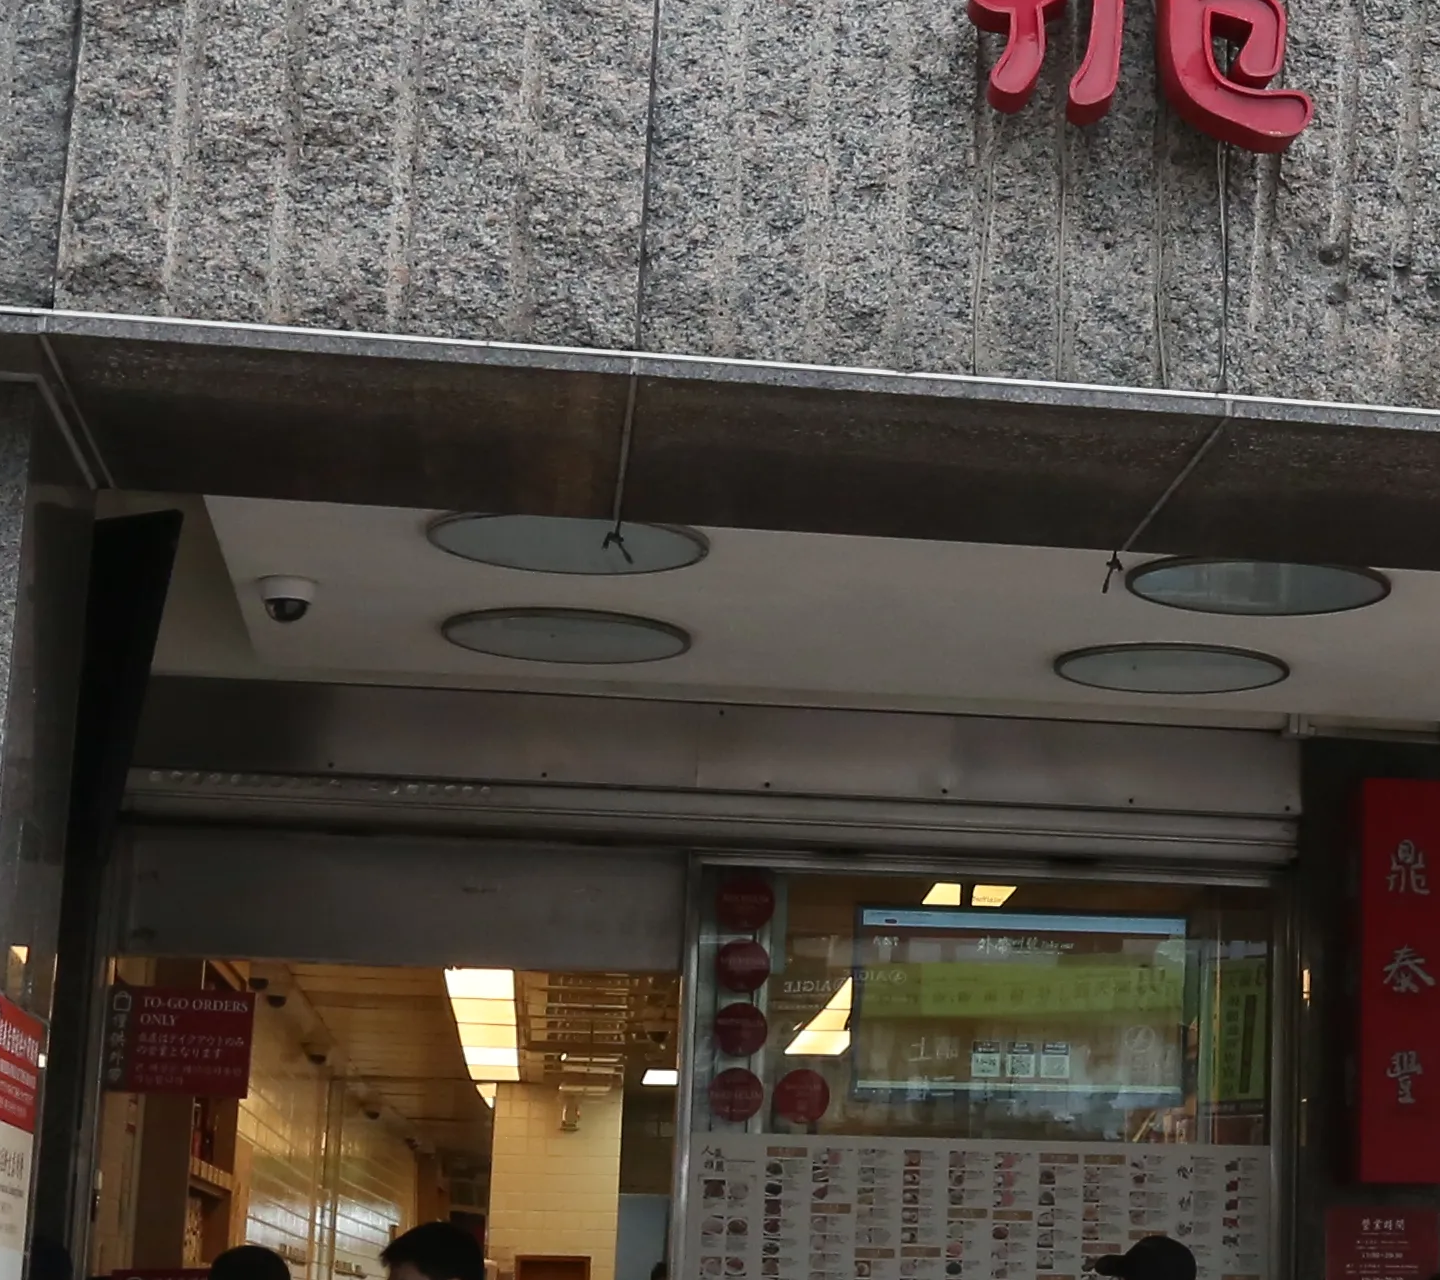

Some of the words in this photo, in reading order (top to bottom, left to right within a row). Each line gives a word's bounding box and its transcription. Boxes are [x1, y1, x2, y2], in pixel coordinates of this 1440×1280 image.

[1383, 839, 1435, 1105] 鼎泰豐
[143, 996, 189, 1010] TO-GO
[192, 999, 248, 1013] ORDERS
[140, 1014, 179, 1026] ONLY
